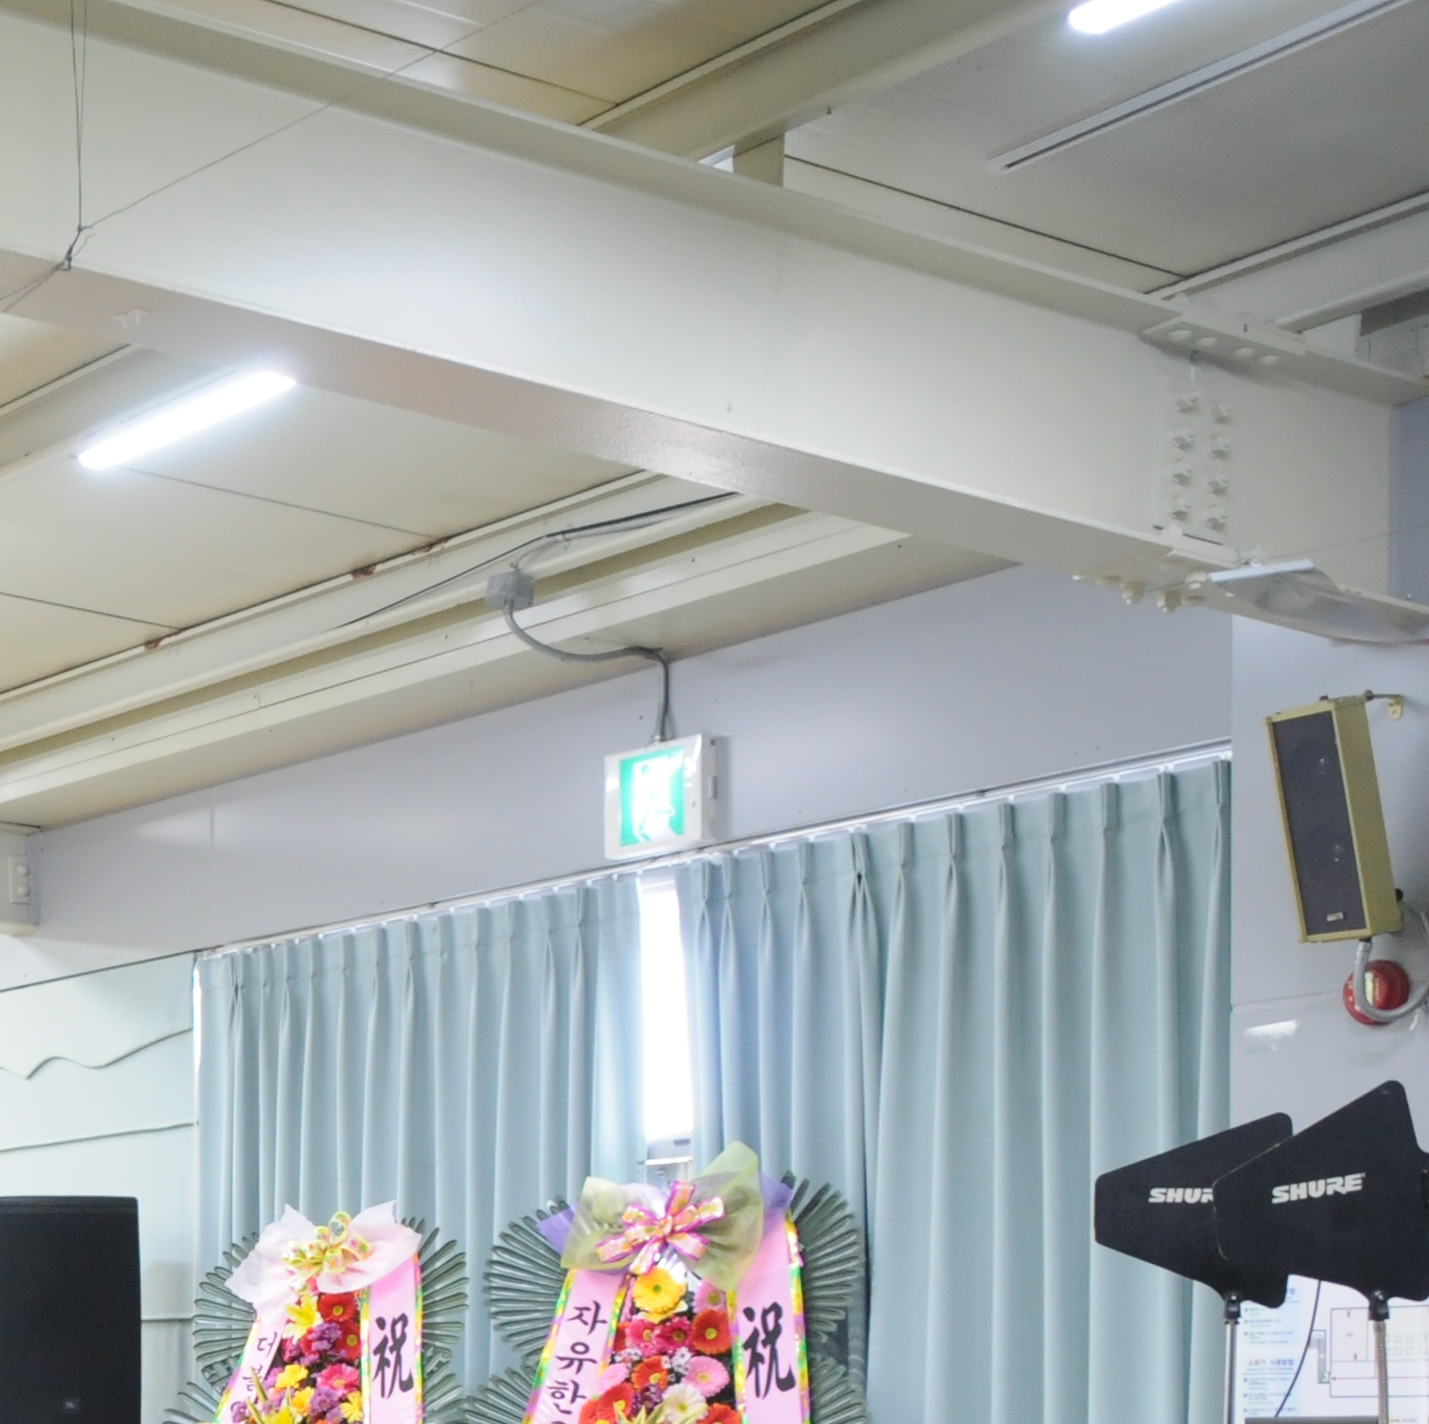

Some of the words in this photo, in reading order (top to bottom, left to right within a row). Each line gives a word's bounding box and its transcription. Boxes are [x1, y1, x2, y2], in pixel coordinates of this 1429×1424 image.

[1148, 1187, 1214, 1204] SHUR
[1271, 1172, 1365, 1205] SHURE
[742, 1300, 797, 1399] 祝
